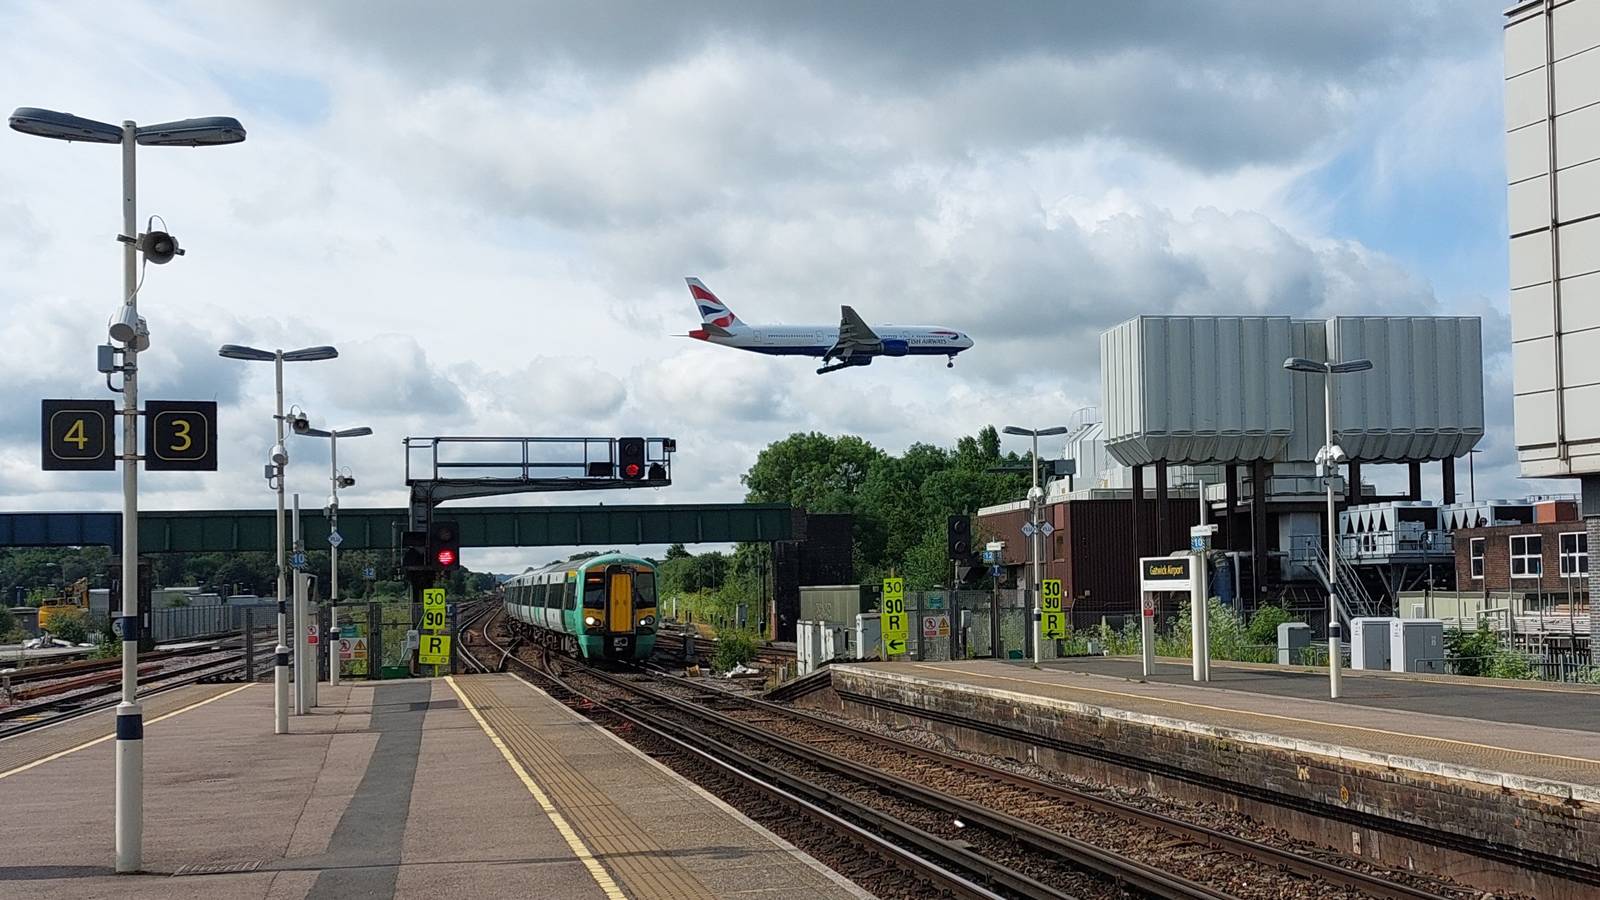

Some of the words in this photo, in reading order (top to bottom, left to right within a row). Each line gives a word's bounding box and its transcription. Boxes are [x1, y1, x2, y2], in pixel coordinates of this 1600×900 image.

[63, 419, 89, 450] 4
[170, 419, 192, 451] 3
[293, 553, 305, 564] 10
[1150, 565, 1167, 575] Gatwick
[1168, 565, 1183, 576] Airport
[885, 581, 902, 594] 30
[1044, 581, 1060, 596] 30
[425, 592, 444, 606] 30
[885, 598, 903, 614] 90
[1045, 597, 1059, 609] 90
[426, 611, 443, 626] 90
[888, 615, 900, 630] R
[1047, 614, 1058, 629] R
[429, 637, 442, 654] R
